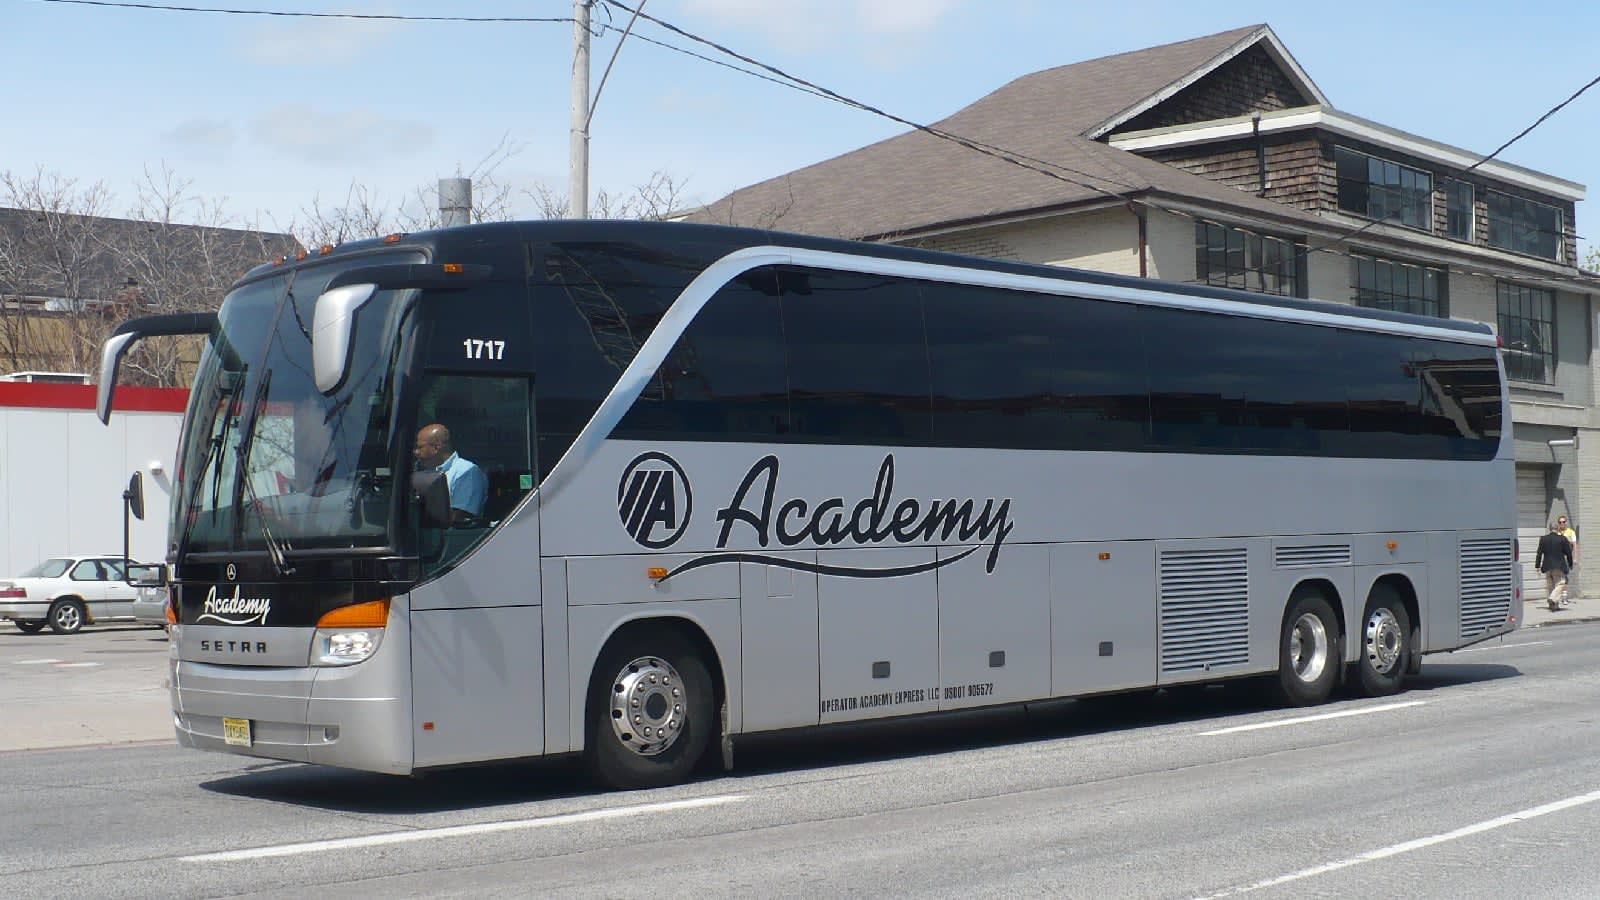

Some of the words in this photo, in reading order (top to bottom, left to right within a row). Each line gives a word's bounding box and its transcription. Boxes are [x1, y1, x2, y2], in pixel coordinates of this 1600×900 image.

[463, 338, 505, 360] 1717
[715, 454, 1014, 575] Academy
[204, 584, 271, 625] Academy
[201, 640, 267, 653] SETRA
[821, 697, 858, 713] OPERATOR
[859, 692, 893, 709] ACADEMY
[895, 689, 924, 705] EXPRESS
[928, 687, 940, 700] LLC
[944, 685, 966, 699] USDOT
